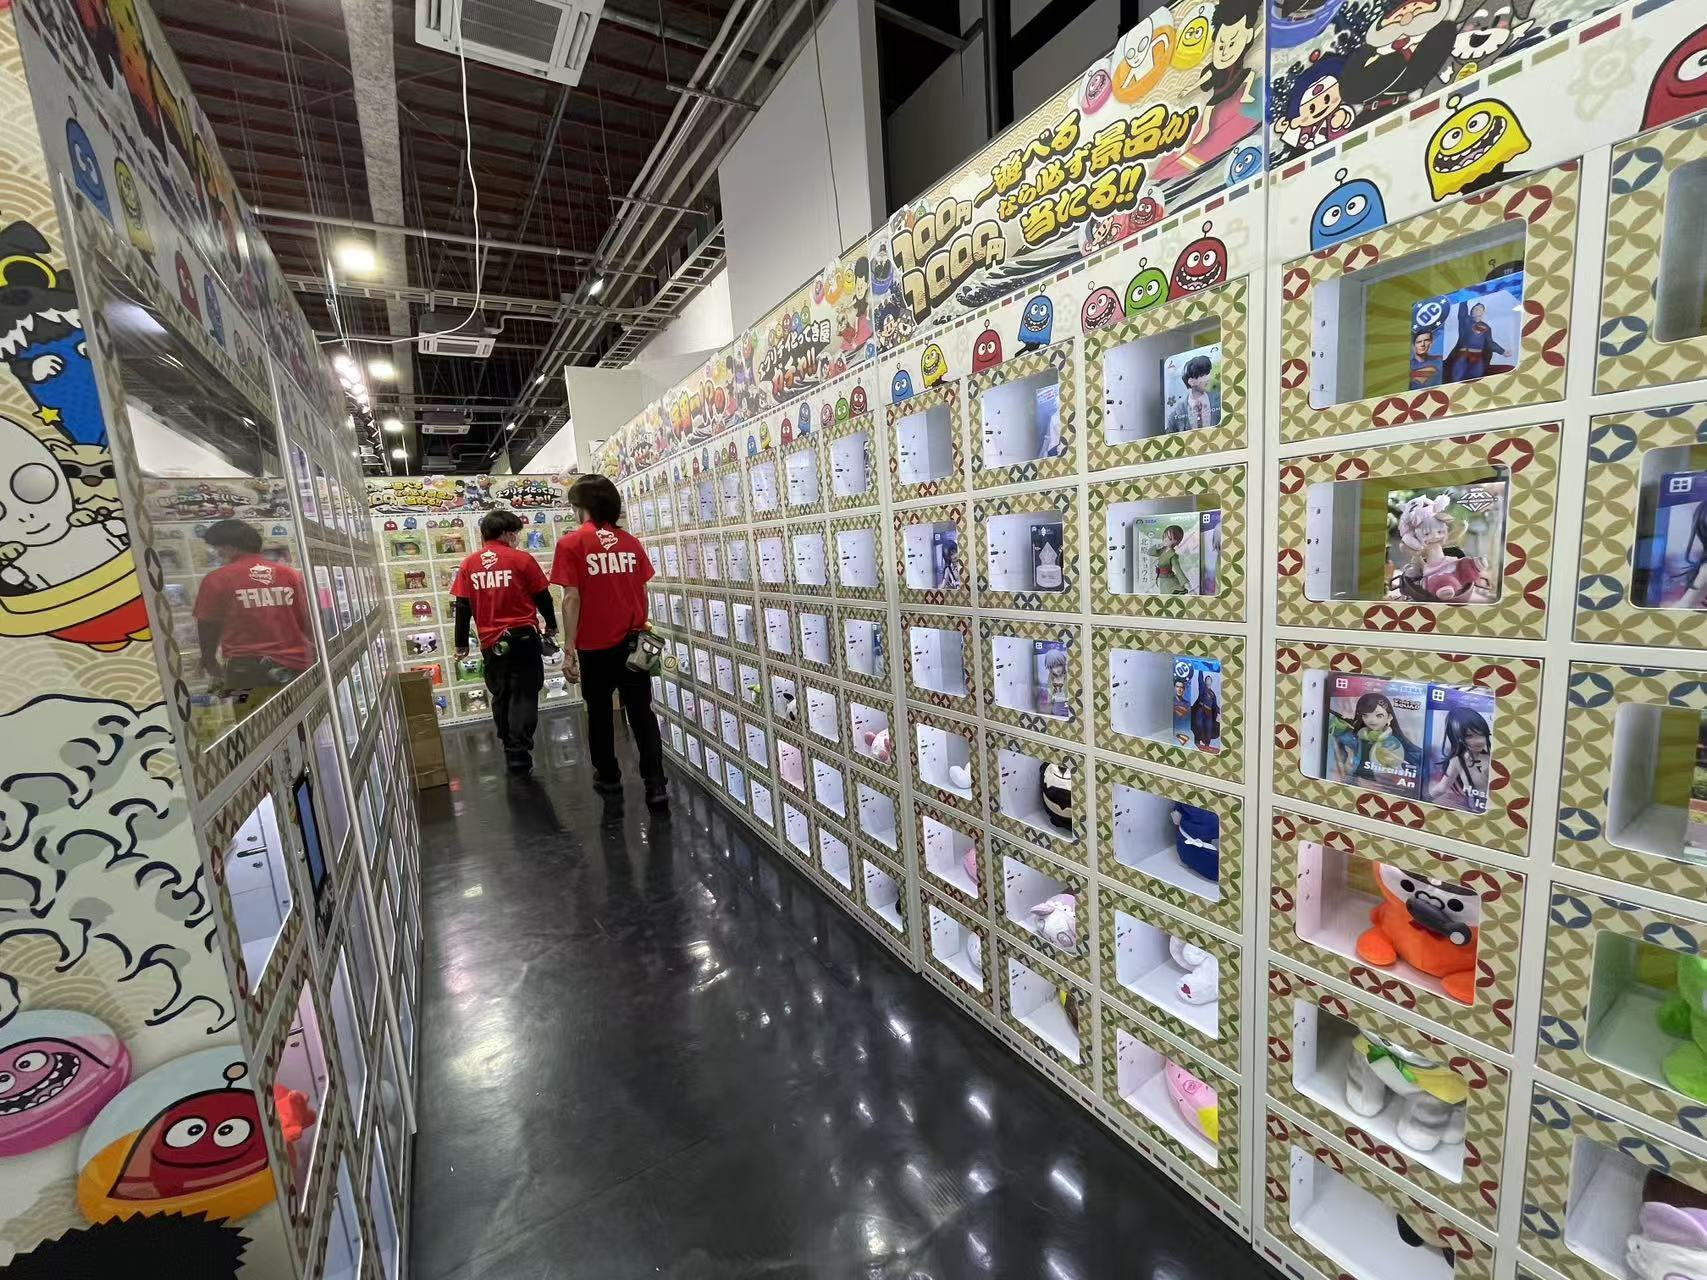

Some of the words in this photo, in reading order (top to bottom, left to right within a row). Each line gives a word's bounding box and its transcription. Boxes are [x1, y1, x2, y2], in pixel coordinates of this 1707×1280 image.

[586, 552, 637, 576] STAFF
[470, 570, 512, 590] STAFF
[1363, 761, 1417, 778] Shiraishi
[1396, 778, 1415, 788] An
[1463, 785, 1488, 798] Hos
